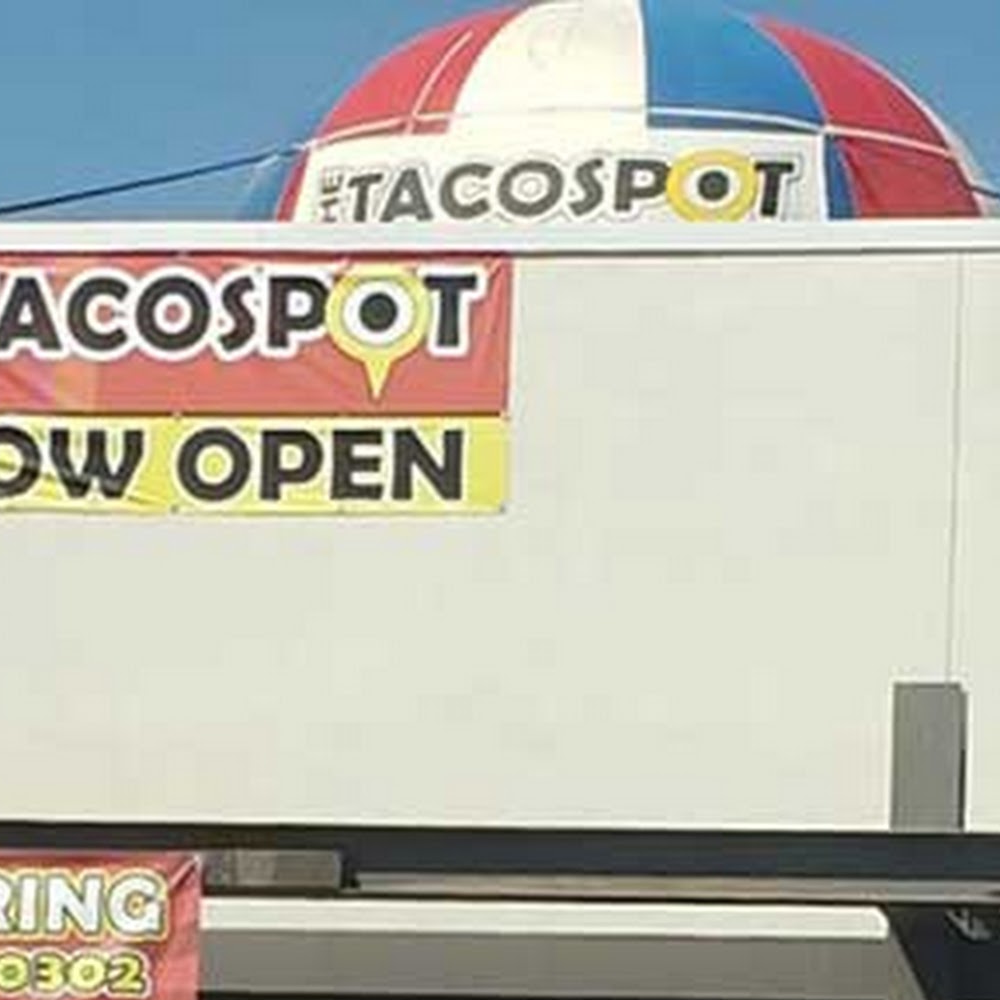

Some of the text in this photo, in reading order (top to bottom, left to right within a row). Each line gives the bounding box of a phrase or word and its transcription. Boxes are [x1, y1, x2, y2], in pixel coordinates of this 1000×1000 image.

[320, 149, 796, 222] HE TACOSPOT
[176, 427, 464, 501] OPEN
